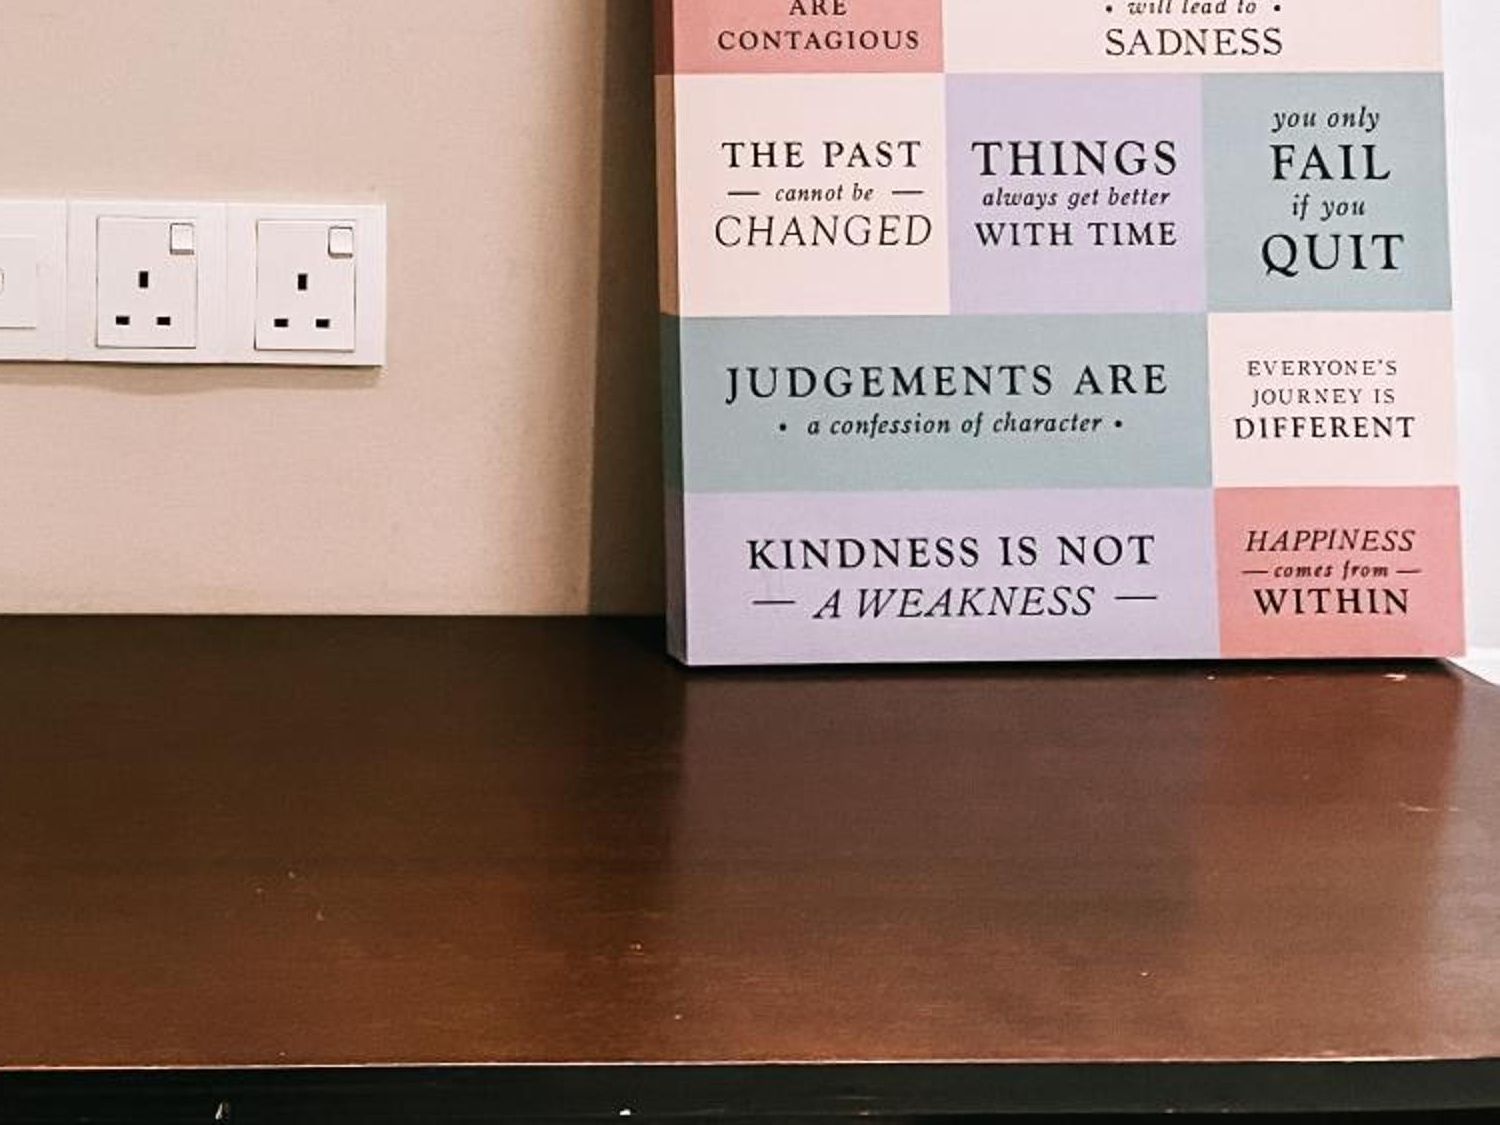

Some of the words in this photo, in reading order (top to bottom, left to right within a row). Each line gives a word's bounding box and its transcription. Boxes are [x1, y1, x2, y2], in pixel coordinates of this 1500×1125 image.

[717, 30, 919, 51] CONTAGIOUS
[1105, 27, 1283, 56] SADNESS
[1271, 112, 1317, 134] you
[1327, 106, 1380, 134] only
[721, 141, 805, 168] THE
[823, 140, 921, 168] PAST
[971, 140, 1177, 176] THINGS
[1269, 144, 1391, 181] FAIL
[775, 184, 844, 202] cannot
[851, 182, 874, 202] be
[981, 186, 1058, 211] always
[1067, 188, 1099, 211] get
[1107, 186, 1171, 206] better
[1292, 192, 1311, 222] if
[1319, 200, 1365, 222] you
[715, 214, 932, 248] CHANGED
[974, 222, 1073, 247] WITH
[1087, 221, 1177, 246] TIME
[1261, 233, 1405, 278] QUIT
[1247, 359, 1397, 377] EVERYONE'S
[725, 364, 1052, 406] JUDGEMENTS
[1074, 364, 1167, 396] ARE
[1251, 388, 1362, 408] JOURNEY
[1374, 388, 1395, 404] IS
[807, 420, 821, 436] a
[829, 412, 951, 439] confession
[961, 411, 984, 438] of
[992, 410, 1103, 433] character
[1234, 416, 1415, 440] DIFFERENT
[746, 536, 979, 570] KINDNESS
[998, 536, 1037, 566] IS
[1056, 534, 1155, 566] NOT
[1245, 528, 1416, 553] HAPPINESS
[1273, 564, 1334, 578] comes
[1342, 560, 1389, 581] from
[812, 588, 841, 620] A
[858, 585, 1096, 619] WEAKNESS
[1253, 587, 1409, 616] WITHIN
